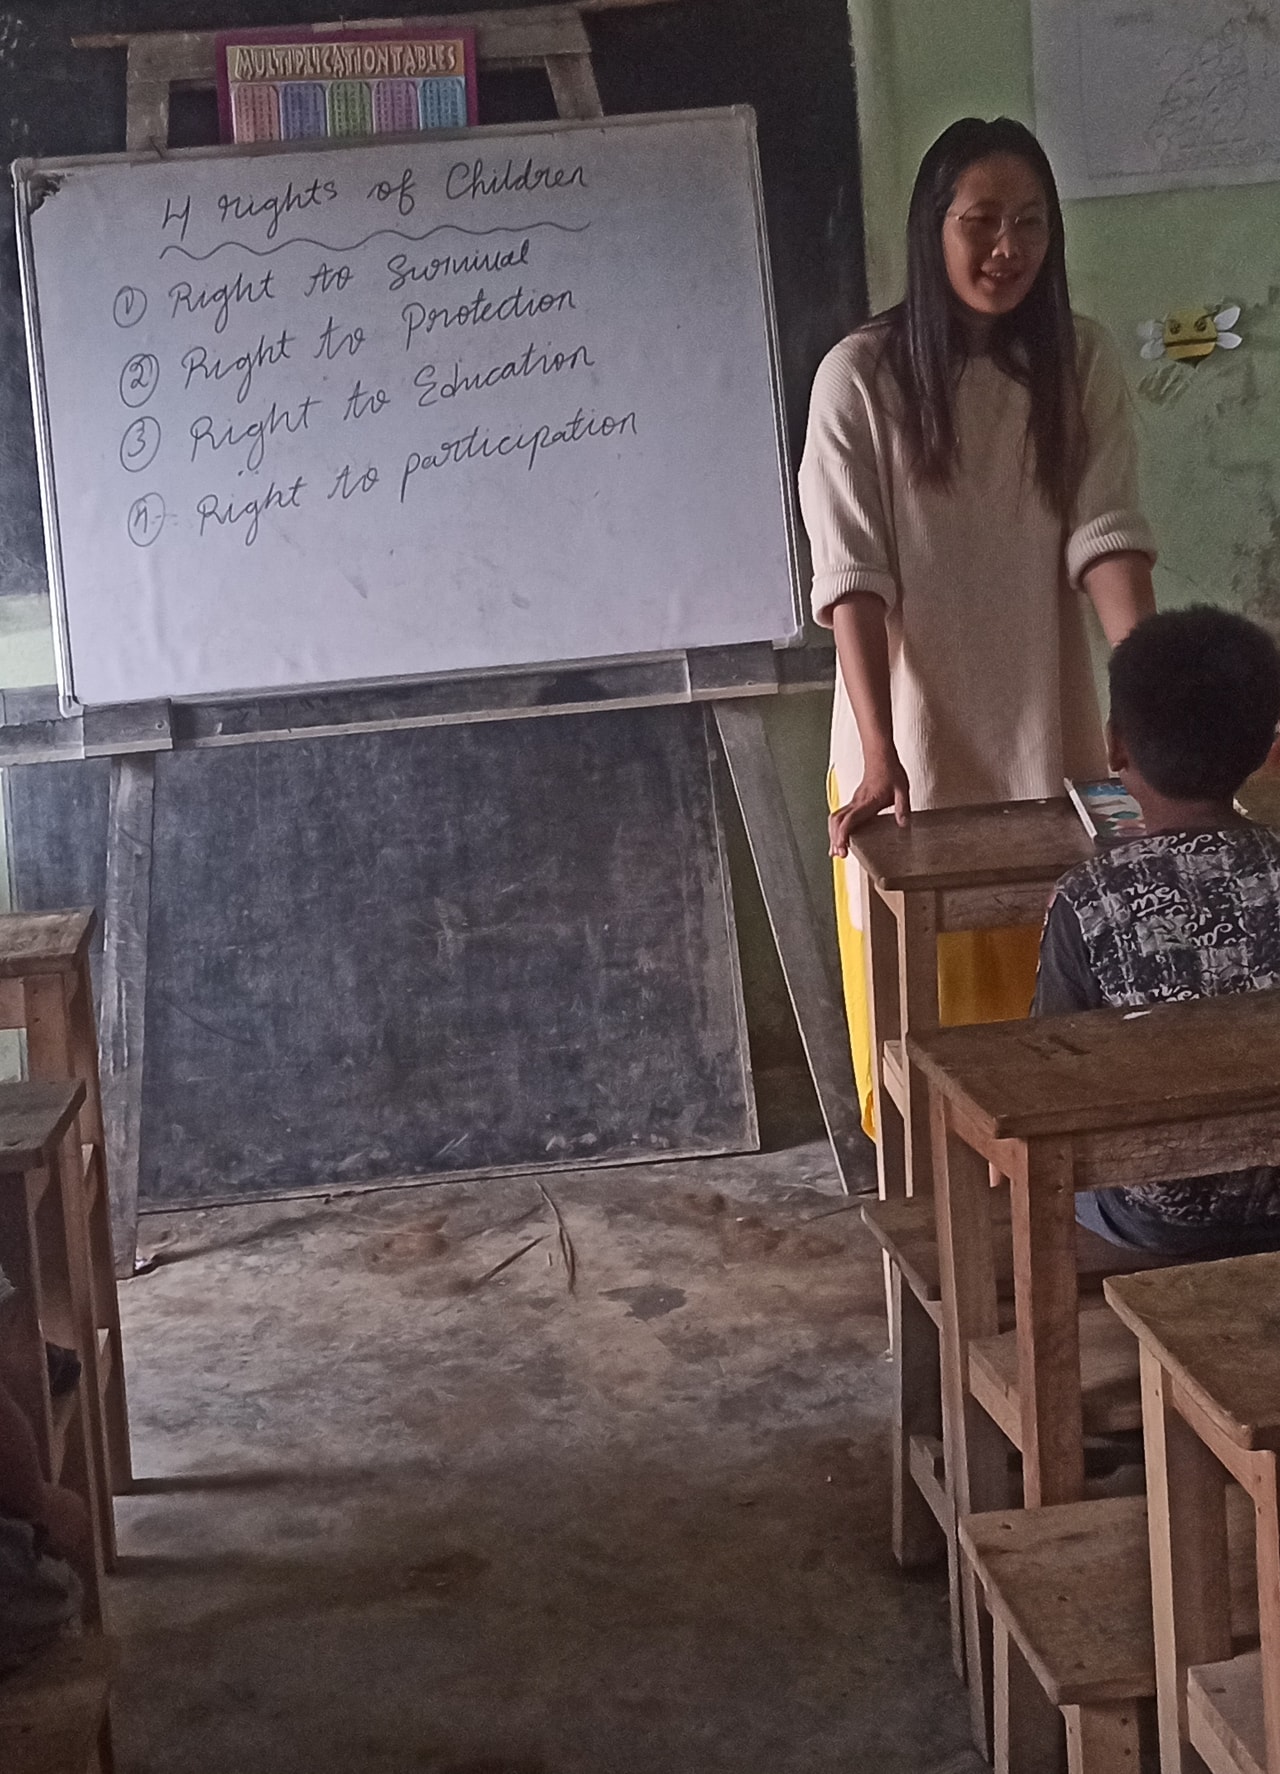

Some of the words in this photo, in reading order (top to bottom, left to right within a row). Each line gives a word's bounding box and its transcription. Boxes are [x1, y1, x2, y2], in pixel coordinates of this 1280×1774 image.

[162, 195, 190, 240] 4
[218, 179, 338, 239] rights
[366, 169, 416, 216] of
[445, 158, 589, 201] Children
[168, 270, 275, 334] Right
[303, 262, 354, 297] to
[181, 329, 296, 404] Right
[314, 316, 366, 360] to
[401, 286, 577, 351] Protection
[190, 396, 321, 471] Right
[343, 380, 391, 421] to
[413, 342, 595, 407] Education
[197, 476, 308, 546] Right
[327, 464, 380, 500] to
